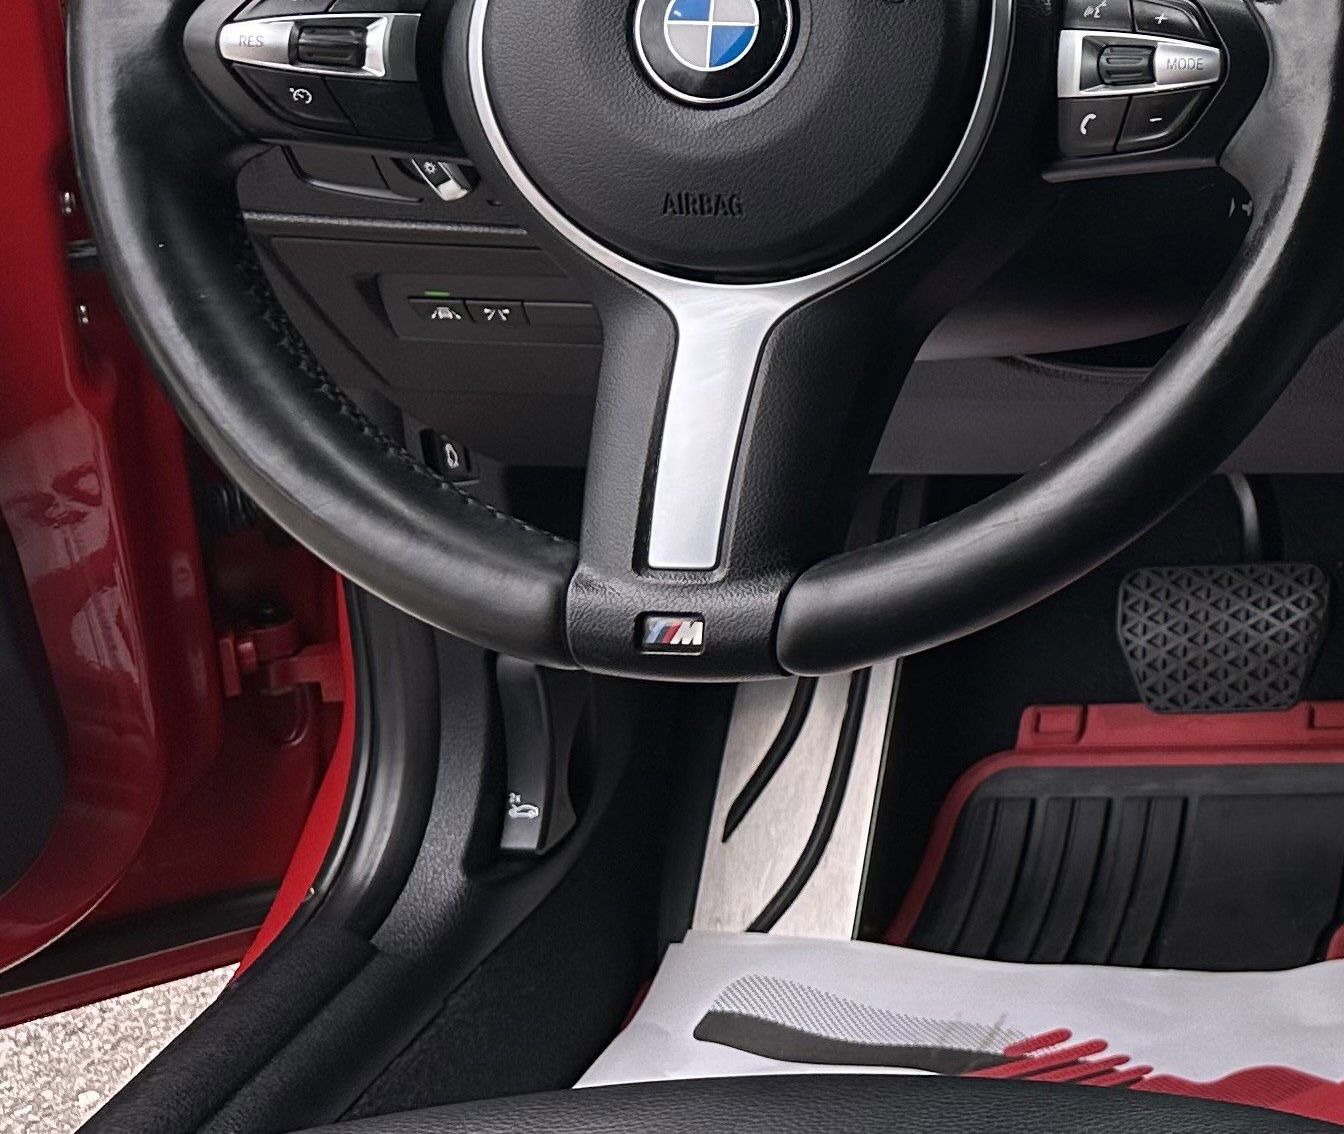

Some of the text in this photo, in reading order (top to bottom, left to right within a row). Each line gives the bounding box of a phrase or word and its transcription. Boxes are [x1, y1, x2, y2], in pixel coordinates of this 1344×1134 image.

[238, 34, 264, 47] RES
[1166, 57, 1204, 71] MODE
[662, 192, 744, 217] AIRBAG
